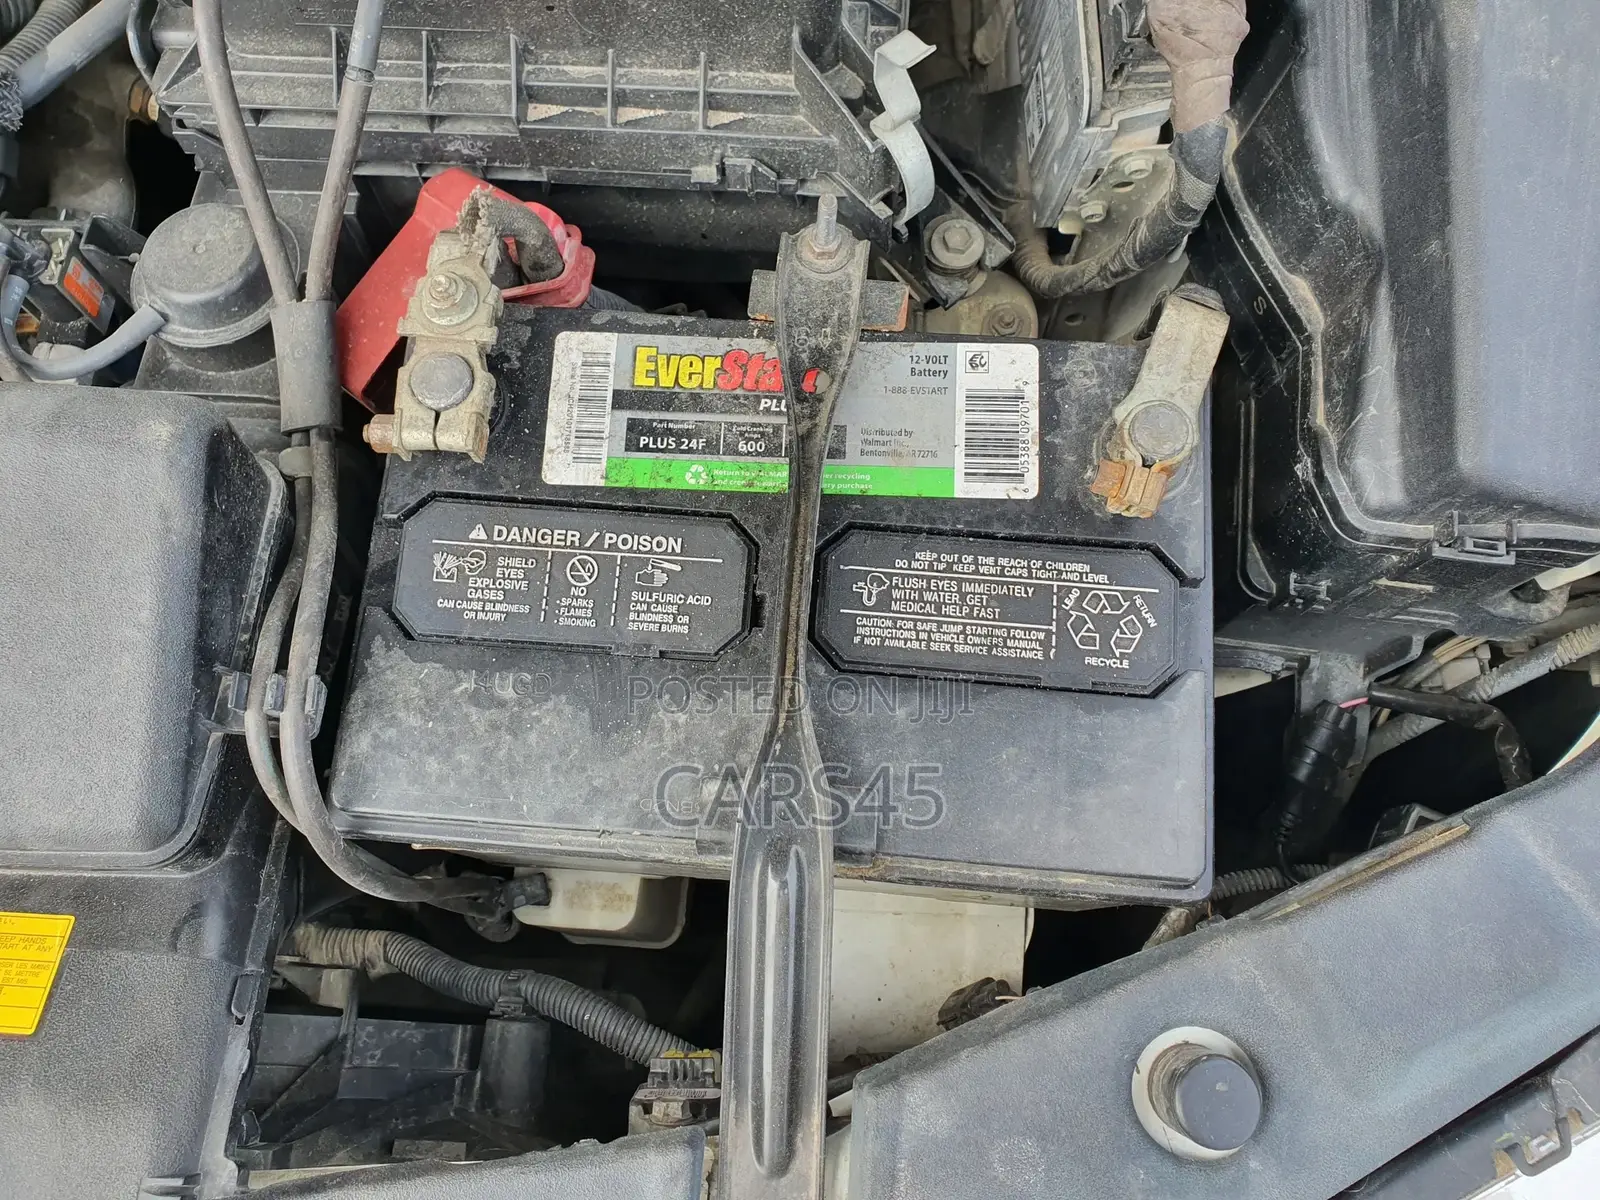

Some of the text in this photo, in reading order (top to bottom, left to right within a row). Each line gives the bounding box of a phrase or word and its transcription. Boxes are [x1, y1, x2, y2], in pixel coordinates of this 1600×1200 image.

[909, 355, 949, 366] 12-VOLT
[910, 367, 949, 379] Battery
[1020, 400, 1030, 433] 09701
[652, 421, 696, 430] Part Number
[860, 427, 914, 438] Distributed by
[638, 436, 707, 451] PLUS 24F
[737, 440, 766, 453] 600
[860, 438, 892, 447] Walmart
[917, 450, 938, 459] 72716
[1020, 439, 1030, 473] 05388
[834, 473, 871, 481] recycling
[836, 482, 873, 491] purchase
[493, 525, 683, 553] DANGER / POISON
[497, 556, 537, 568] SHIELD
[915, 551, 1091, 573] KEEP OUT OF THE REACH OF CHILDREN
[496, 568, 525, 579] EYES
[895, 559, 1110, 584] DO NOT TIP KEEP VENT CAPS TIGHT AND LEVEL
[468, 577, 529, 591] EXPLOSIVE
[892, 576, 1035, 598] FLUSH EYES IMMEDIATELY
[467, 588, 505, 600] GASES
[570, 586, 587, 597] NO
[892, 588, 919, 601] WITH
[966, 594, 988, 606] GET
[560, 597, 594, 608] SPARKS
[631, 591, 713, 606] SULFURIC ACID
[1062, 588, 1081, 610] LEAD
[437, 598, 531, 614] CAN CAUSE BLINDNESS
[630, 602, 679, 614] CAN CAUSE
[891, 601, 1001, 620] MEDICAL HELP FAST
[1133, 594, 1157, 628] RETURN
[463, 610, 507, 622] OR INJURY
[559, 607, 593, 618] FLAMES
[629, 612, 690, 624] BLINDNESS OR
[558, 617, 597, 628] SMOKING
[628, 622, 689, 634] SEVERE BURNS
[896, 620, 914, 630] FOR
[916, 621, 938, 632] SAFE
[939, 622, 963, 633] JUMP
[965, 624, 1008, 637] STARTING
[1010, 629, 1046, 640] FOLLOW
[856, 626, 1043, 650] INSTRUCTIONS IN VEHICLE OWNERS MANUAL
[853, 636, 1044, 660] IF NOT AVAILABLE SEEK SERVICE ASSISTANCE
[1085, 656, 1130, 669] RECYCLE
[19, 936, 48, 945] HANDS
[36, 945, 54, 953] ANY
